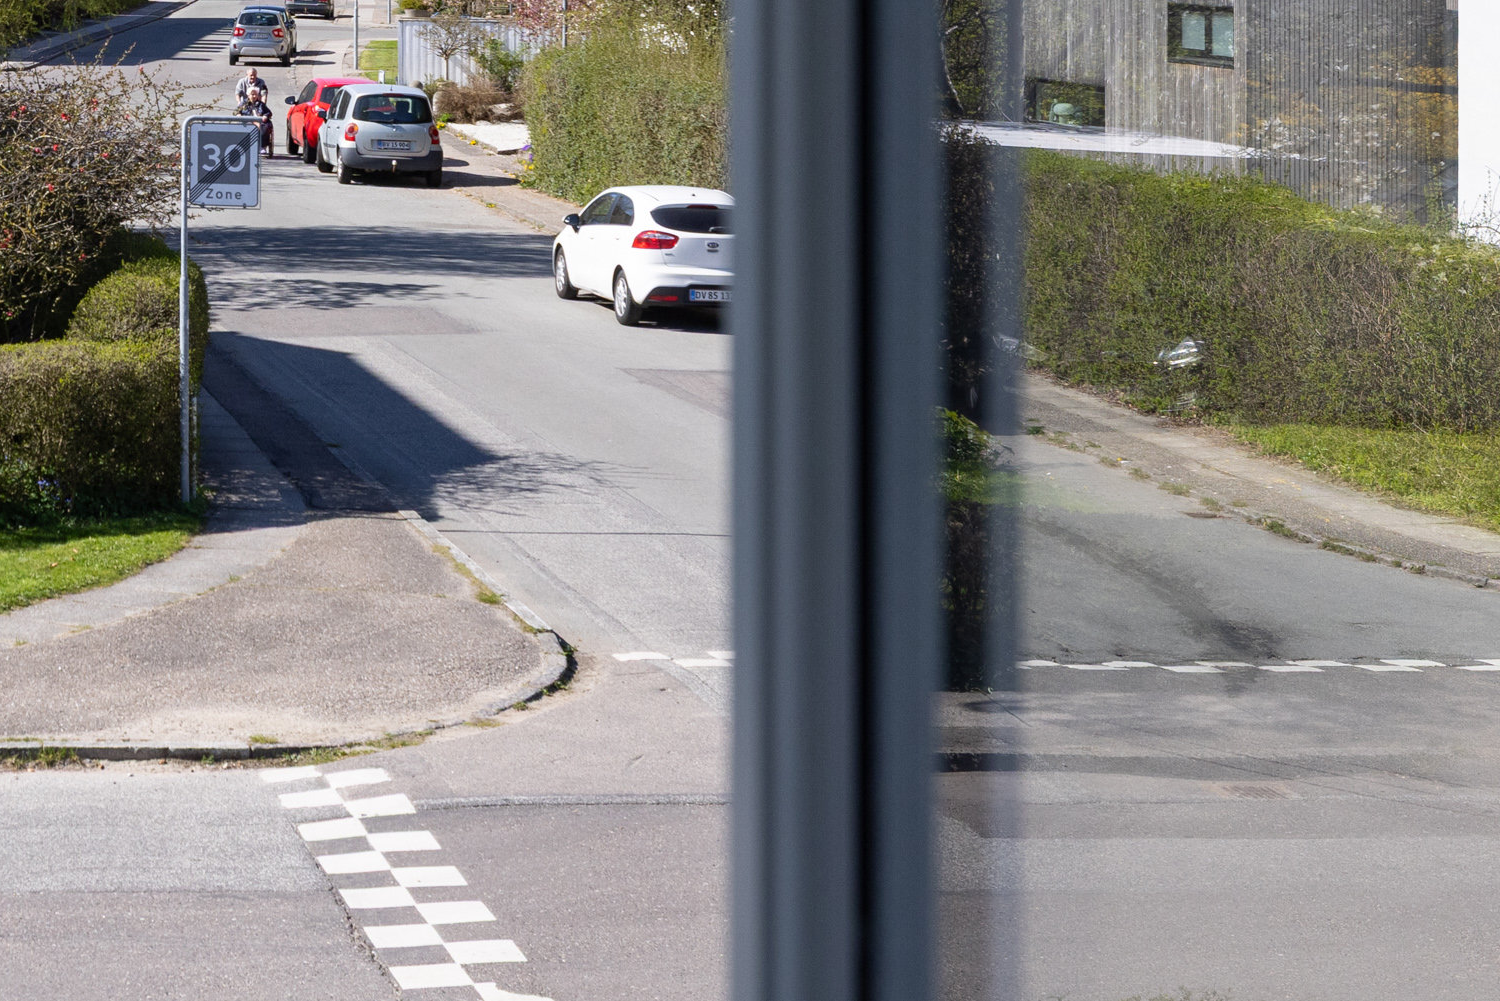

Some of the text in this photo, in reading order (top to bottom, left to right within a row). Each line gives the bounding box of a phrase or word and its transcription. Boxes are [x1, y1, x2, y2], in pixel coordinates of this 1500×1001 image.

[202, 143, 246, 173] 30
[206, 188, 243, 200] Zone
[695, 291, 707, 299] DV
[708, 291, 718, 300] 85
